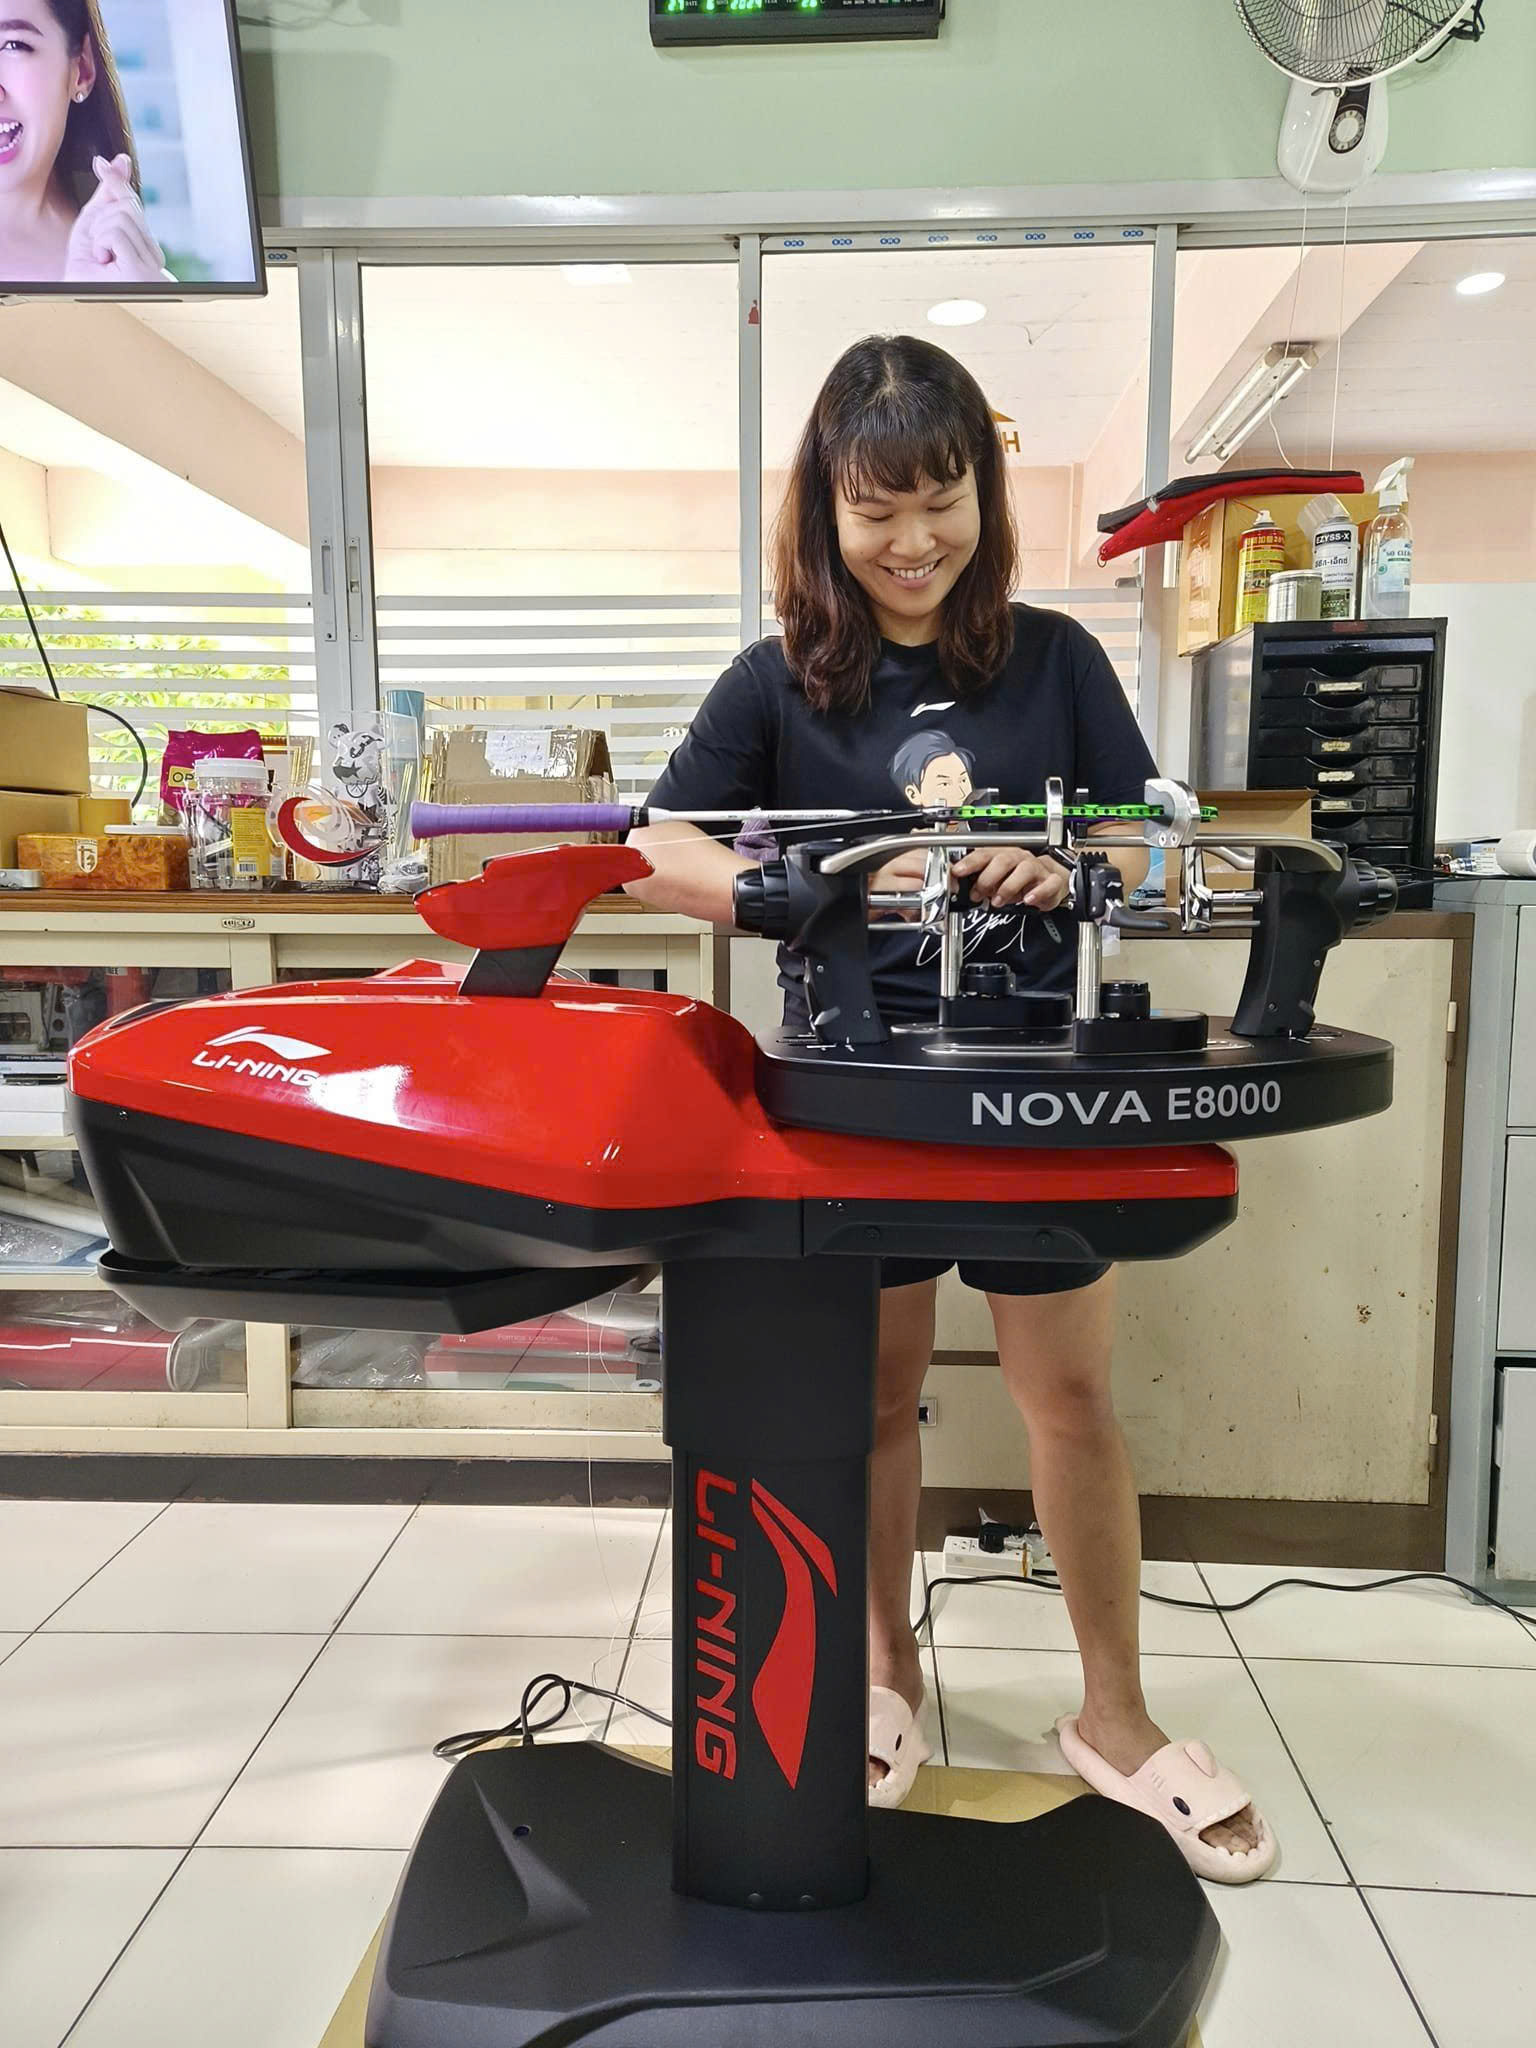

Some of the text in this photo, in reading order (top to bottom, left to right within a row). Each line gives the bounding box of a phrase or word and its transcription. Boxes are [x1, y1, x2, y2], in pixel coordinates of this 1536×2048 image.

[1316, 532, 1350, 545] EZYSS-X
[191, 1050, 321, 1088] LI-NING
[971, 1080, 1281, 1127] NOVA E8000
[695, 1468, 737, 1781] LI-NING
